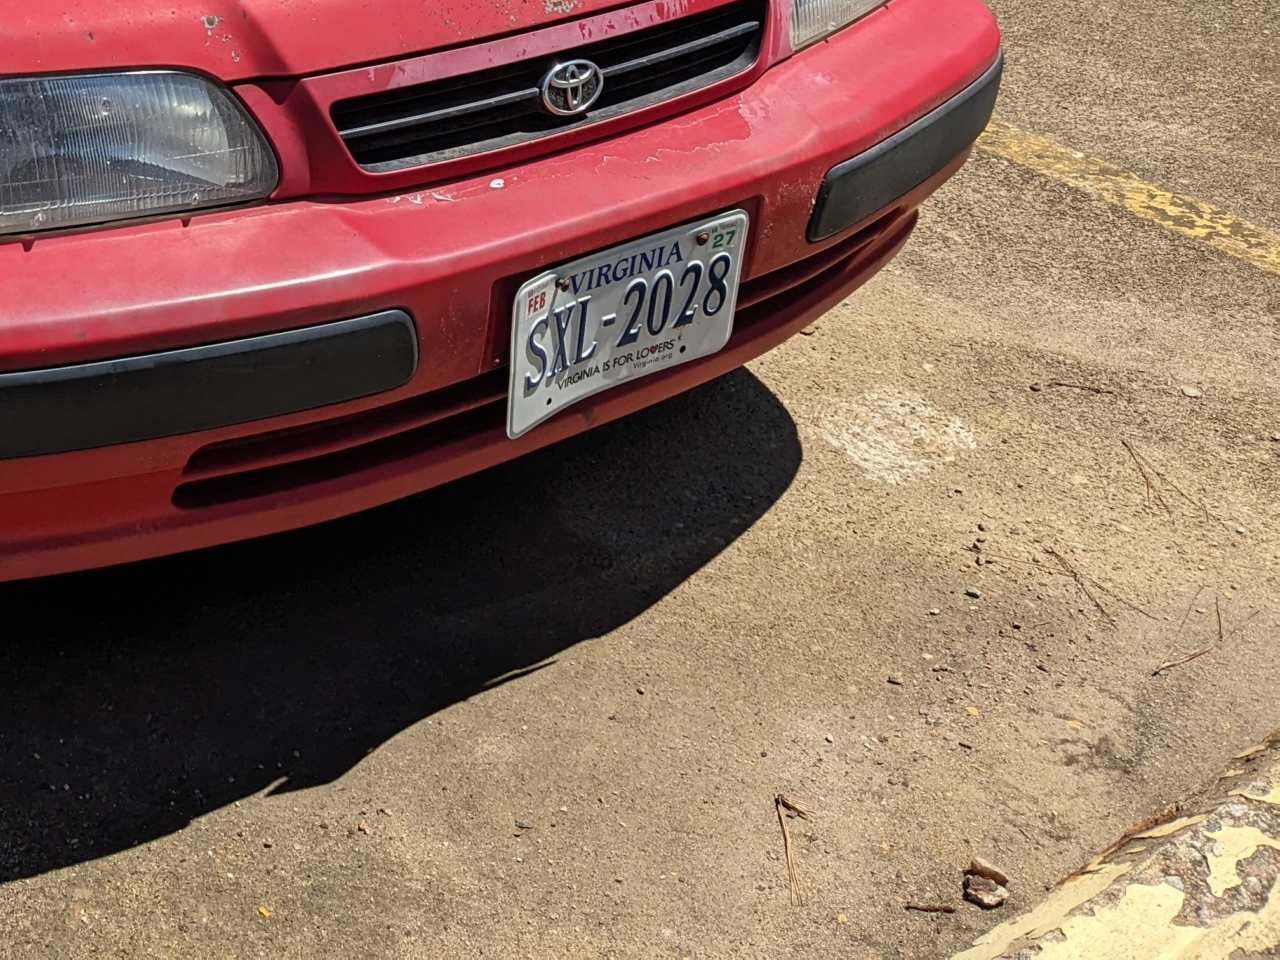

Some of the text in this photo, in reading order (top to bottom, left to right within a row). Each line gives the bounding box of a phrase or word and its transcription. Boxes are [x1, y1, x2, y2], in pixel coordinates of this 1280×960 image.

[712, 230, 736, 248] 27
[570, 241, 684, 295] VIRGINIA
[528, 291, 546, 316] FEB
[524, 252, 731, 391] SXL-2028
[557, 366, 600, 390] VIRGINIA
[602, 360, 610, 372] IS
[613, 353, 633, 368] FOR
[633, 352, 672, 369] Virginia.org
